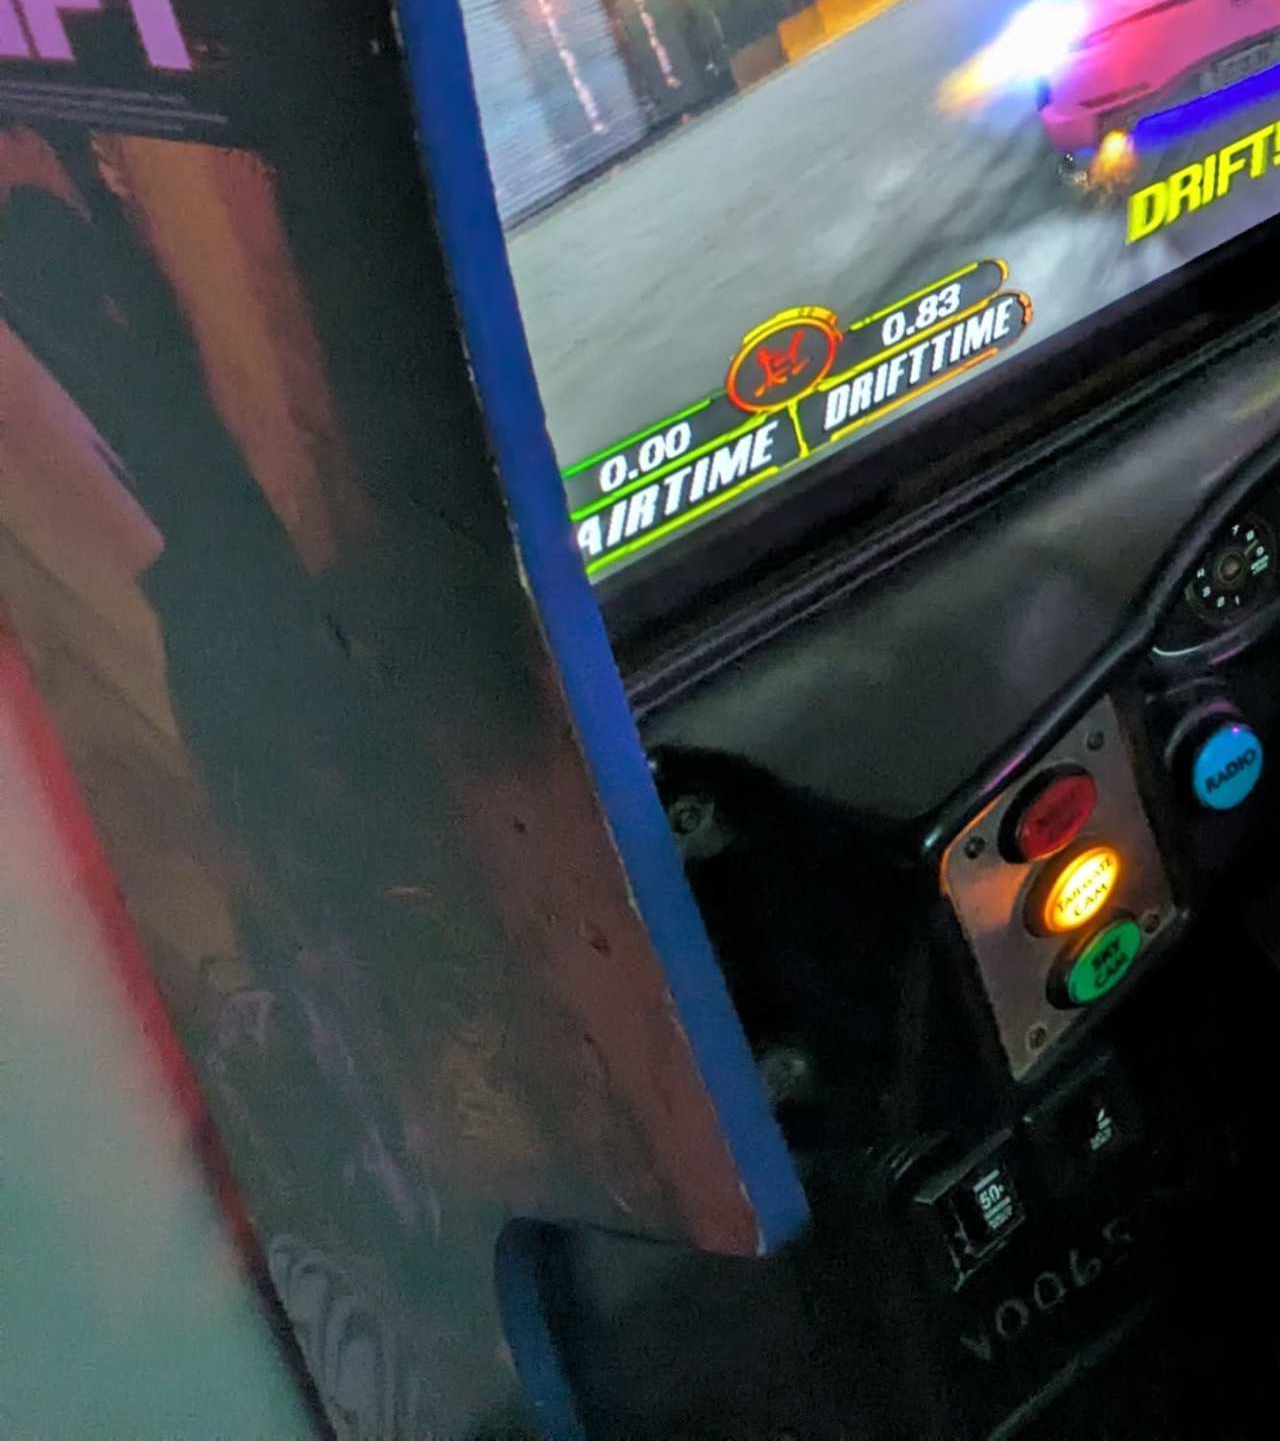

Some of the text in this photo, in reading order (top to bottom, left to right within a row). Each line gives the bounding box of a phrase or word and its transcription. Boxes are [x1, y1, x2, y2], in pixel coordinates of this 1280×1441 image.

[881, 283, 961, 345] 0.83
[576, 420, 779, 557] AIRTIME
[599, 421, 692, 494] 0.00
[1204, 746, 1258, 794] RADIO
